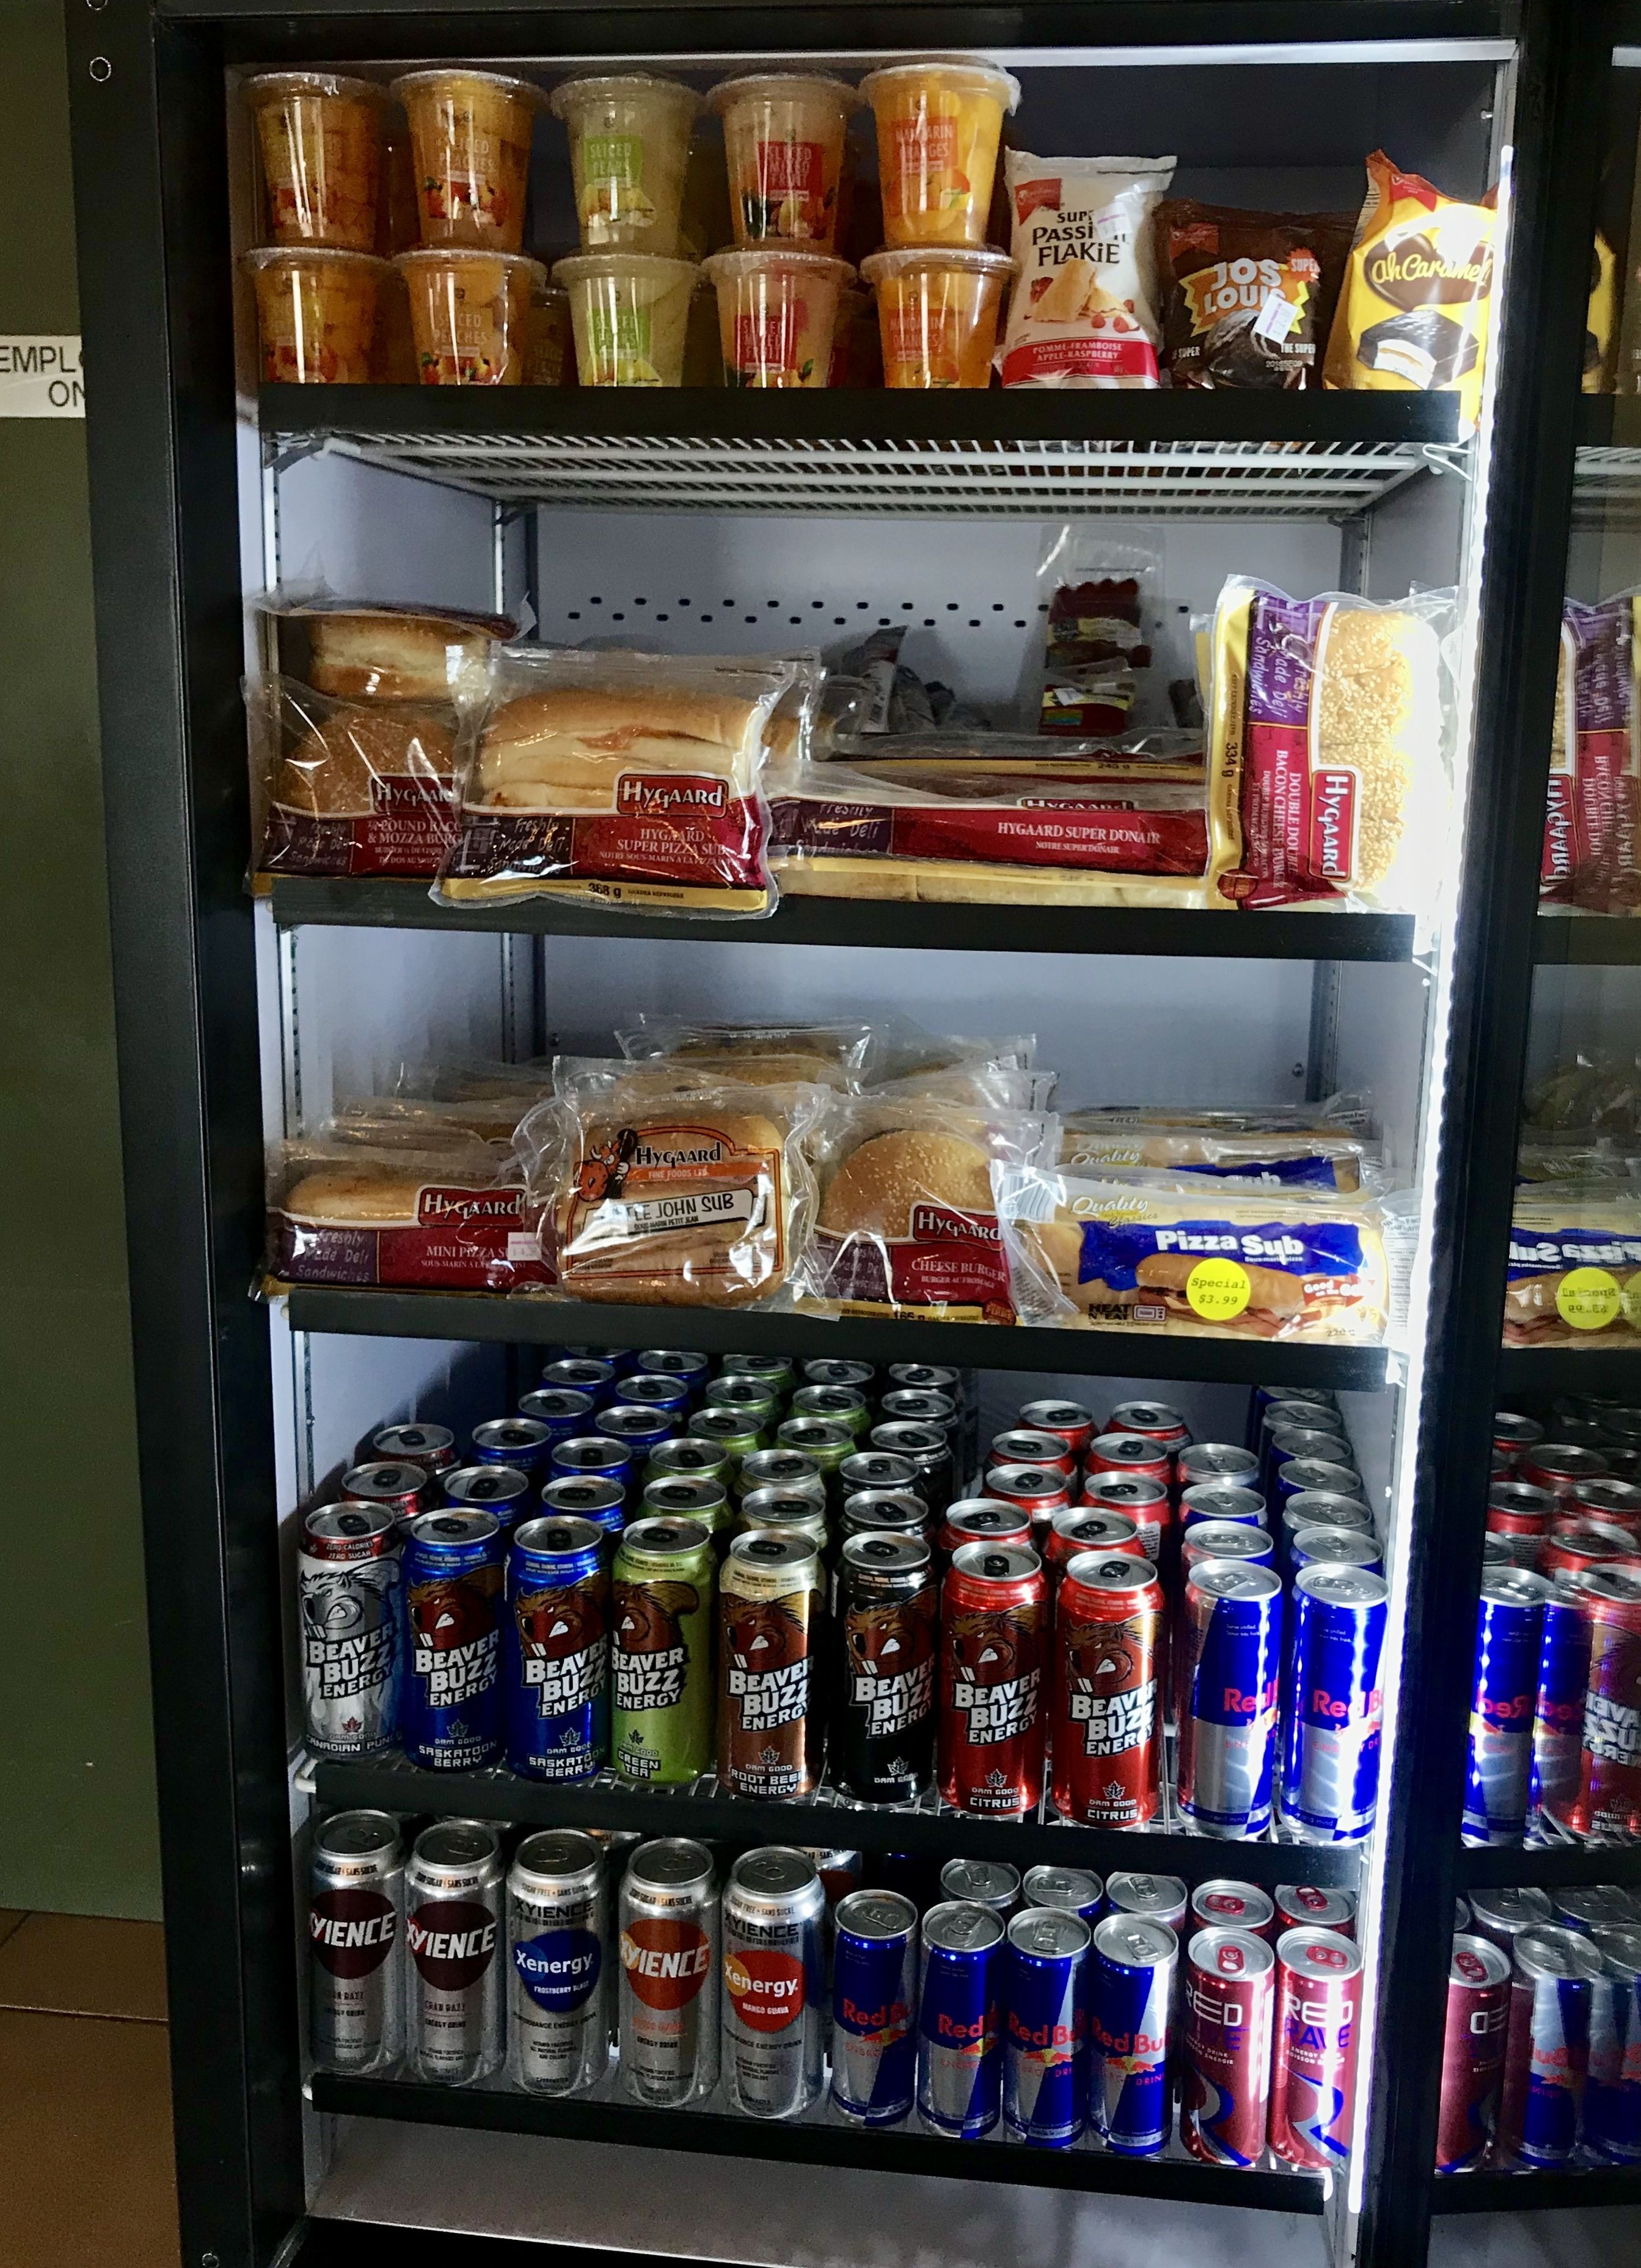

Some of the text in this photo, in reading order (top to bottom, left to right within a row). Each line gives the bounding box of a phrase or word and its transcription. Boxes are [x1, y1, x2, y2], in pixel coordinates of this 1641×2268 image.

[1211, 257, 1282, 291] JOS
[0, 346, 83, 373] EMPL
[1037, 350, 1119, 362] APPLE-RASPBERRY
[1224, 742, 1238, 766] 334
[1221, 769, 1235, 778] g
[1274, 749, 1288, 798] BACON
[1287, 772, 1301, 824] DOUBLE
[998, 822, 1161, 844] HYGAARD SUPER DONAIR
[1272, 800, 1287, 845] CHEESE
[616, 840, 658, 852] SUPER
[661, 841, 698, 855] PIZZA
[641, 828, 704, 843] HYGAARD
[588, 883, 610, 896] 368
[613, 888, 622, 899] g
[648, 1171, 692, 1179] FINE FOODS
[656, 1193, 734, 1218] JOHN SUB
[1070, 1194, 1149, 1218] Quality
[426, 1246, 456, 1257] MINI
[1155, 1229, 1304, 1256] Pizza Sub
[911, 1259, 1007, 1282] CHEESE BURGER
[1191, 1276, 1246, 1290] Special
[1304, 1279, 1334, 1293] Good
[1088, 1303, 1131, 1314] HEAT
[1199, 1294, 1238, 1306] $3.99
[348, 1550, 372, 1559] SUGAR
[310, 1621, 393, 1663] BEAVER
[415, 1629, 500, 1674] BEAVER
[323, 1642, 392, 1685] BUZZ
[429, 1650, 496, 1693] BUZZ
[525, 1633, 608, 1685] BEAVER
[612, 1646, 684, 1676] BEAVER
[323, 1666, 392, 1697] ENERGY
[429, 1672, 497, 1708] ENERGY
[542, 1656, 606, 1703] BUZZ
[616, 1671, 680, 1696] BUZZ
[855, 1653, 935, 1703] BEAVER
[955, 1667, 1040, 1707] BEAVER
[541, 1678, 605, 1717] ENERGY
[616, 1688, 681, 1710] ENERGY
[744, 1679, 810, 1716] BUZZ
[872, 1679, 933, 1721] BUZZ
[970, 1689, 1037, 1729] BUZZ
[969, 1714, 1036, 1744] ENERGY
[434, 1755, 481, 1768] BERRY
[618, 1750, 660, 1770] GREEN
[624, 1765, 649, 1779] TEA
[731, 1769, 766, 1785] ROOT
[740, 1781, 798, 1795] ENERGY
[969, 1795, 1020, 1808] CITRUS
[1087, 1807, 1139, 1820] CITRUS
[514, 1896, 596, 1919] XYIENCE
[725, 1908, 800, 1939] XYIENCE
[767, 2005, 789, 2015] GUAVA
[842, 1998, 887, 2027] Red
[938, 2013, 984, 2039] Red
[1007, 2010, 1047, 2045] Red
[1291, 2046, 1318, 2058] ENERGY
